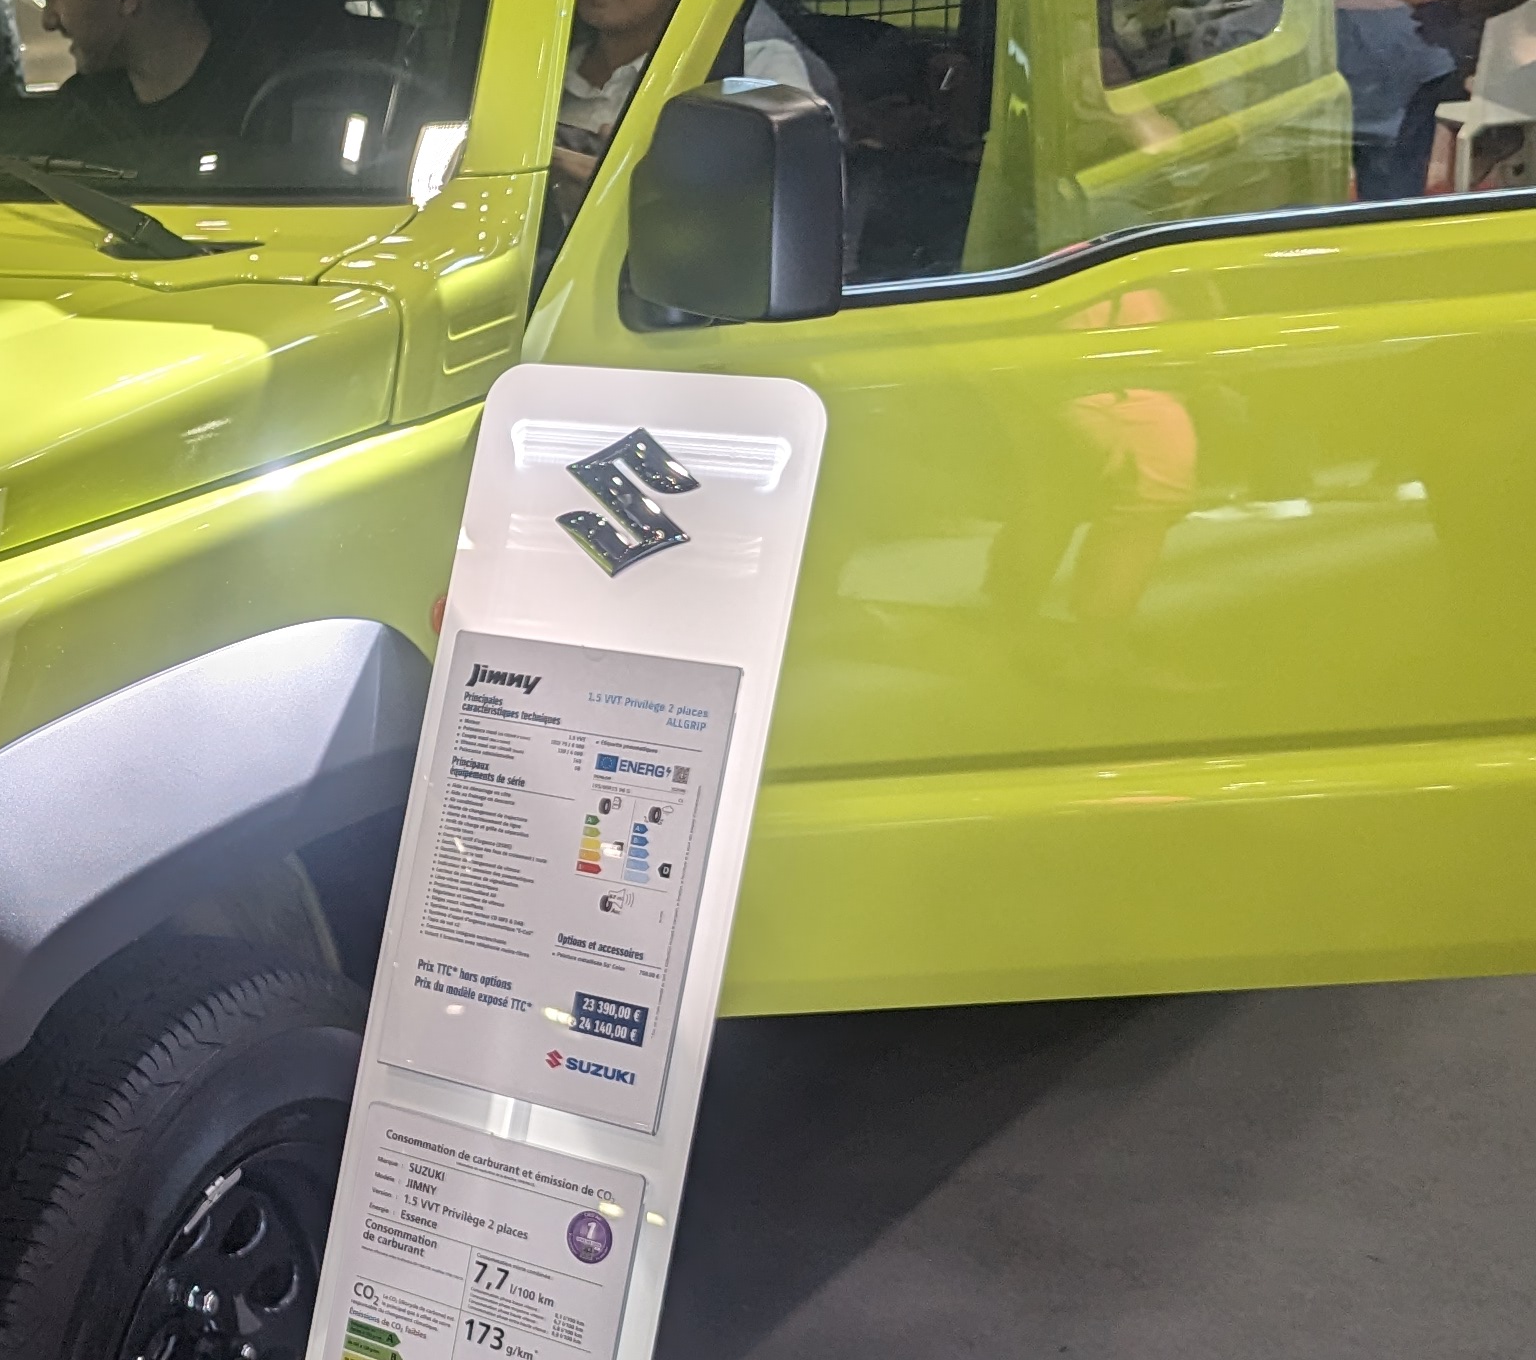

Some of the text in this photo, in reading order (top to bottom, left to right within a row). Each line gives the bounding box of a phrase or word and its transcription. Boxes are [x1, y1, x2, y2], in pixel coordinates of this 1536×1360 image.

[465, 663, 542, 695] Jimny
[588, 691, 709, 718] 1.5 VVT Privilège 2 places
[665, 717, 707, 732] ALLGRIP
[451, 755, 490, 771] Principaux
[618, 759, 666, 778] ENERG
[496, 773, 506, 783] de
[507, 776, 526, 788] série
[557, 932, 644, 961] Options et accessoires
[417, 959, 434, 973] Prix
[459, 968, 478, 983] hors
[480, 975, 513, 991] options
[414, 975, 431, 990] Prix
[433, 980, 444, 993] du
[445, 984, 476, 1000] modèle
[477, 992, 509, 1008] exposé
[582, 997, 642, 1023] 23 390,00 €
[578, 1016, 638, 1042] 24 140,00 €
[565, 1056, 636, 1086] SUZUKI
[386, 1128, 456, 1158] Consommation
[458, 1150, 471, 1162] de
[472, 1154, 521, 1177] carburant
[522, 1168, 533, 1180] et
[534, 1170, 579, 1193] émission
[581, 1184, 594, 1197] de
[408, 1161, 446, 1182] SUZUKI
[405, 1178, 437, 1196] JIMNY
[400, 1209, 438, 1230] Essence
[404, 1193, 418, 1207] 1.5
[420, 1198, 441, 1213] VVT
[442, 1205, 486, 1229] Privilège
[487, 1218, 495, 1230] 2
[496, 1222, 529, 1240] places
[362, 1230, 425, 1258] de carburant
[364, 1218, 438, 1249] Consommation
[473, 1259, 509, 1291] 7,7
[509, 1283, 536, 1301] l/100
[537, 1292, 555, 1308] km
[385, 1333, 394, 1344] A
[464, 1317, 505, 1351] 173
